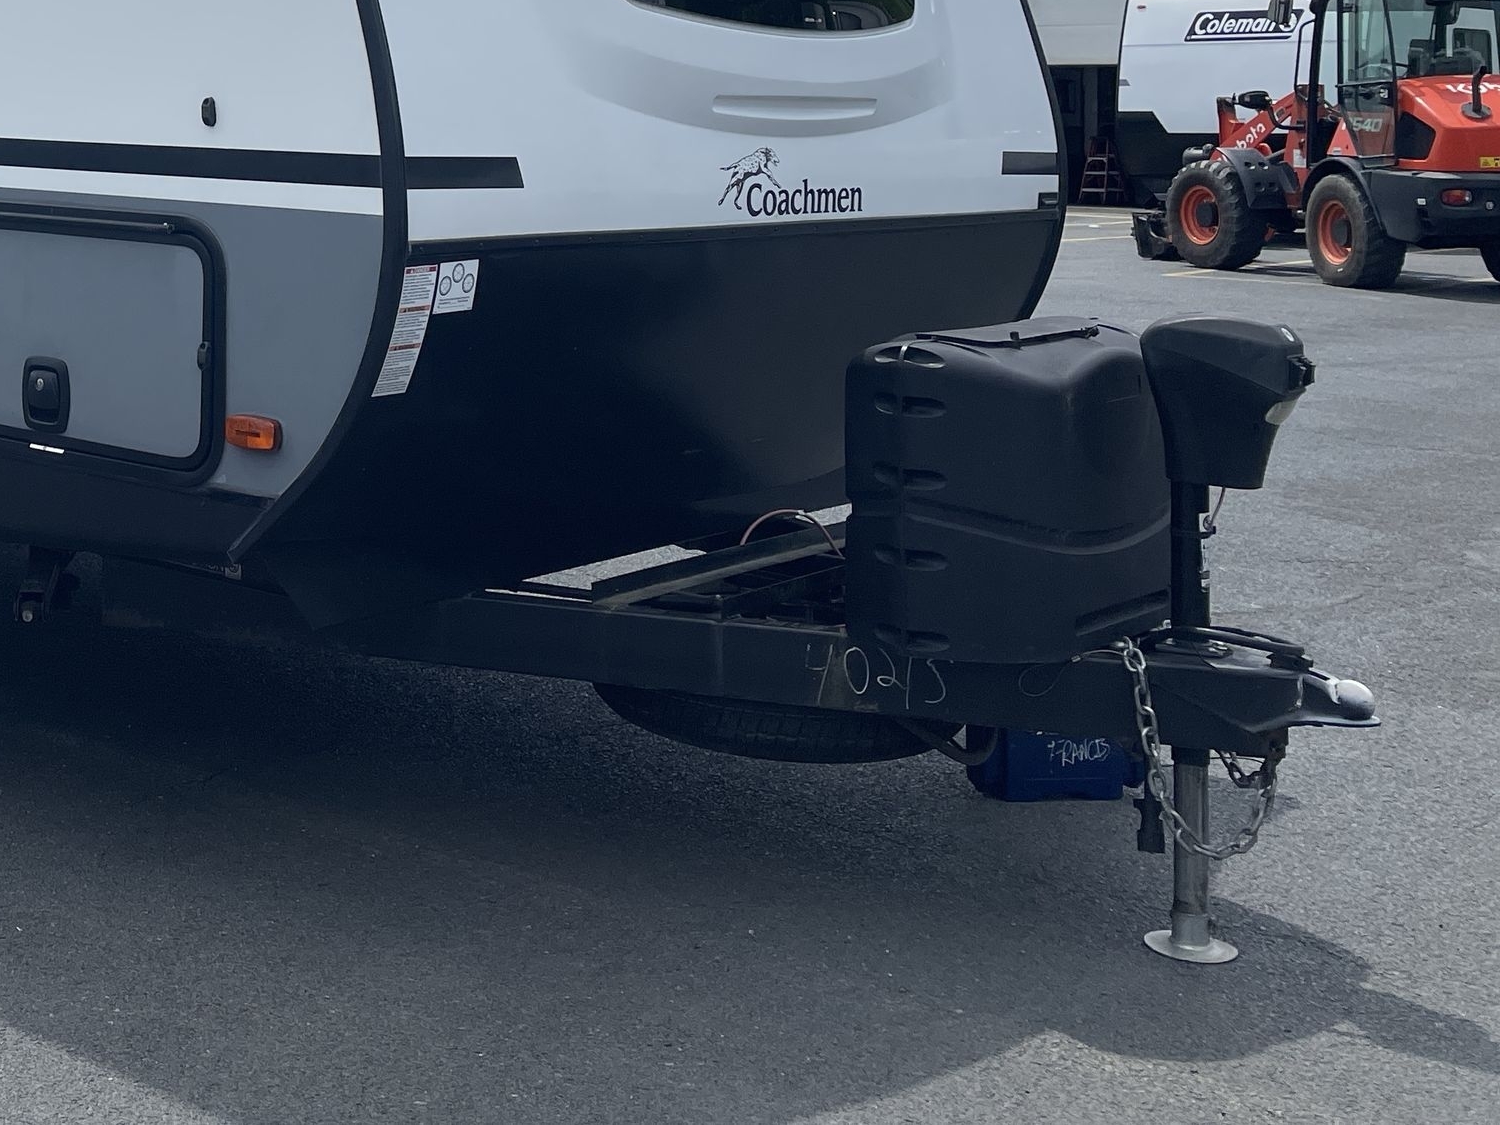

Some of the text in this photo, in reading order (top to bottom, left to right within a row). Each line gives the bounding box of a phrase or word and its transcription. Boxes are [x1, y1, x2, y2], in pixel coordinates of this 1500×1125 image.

[1194, 12, 1277, 35] Coleman
[1348, 117, 1384, 133] 540
[746, 179, 863, 217] Coachmen
